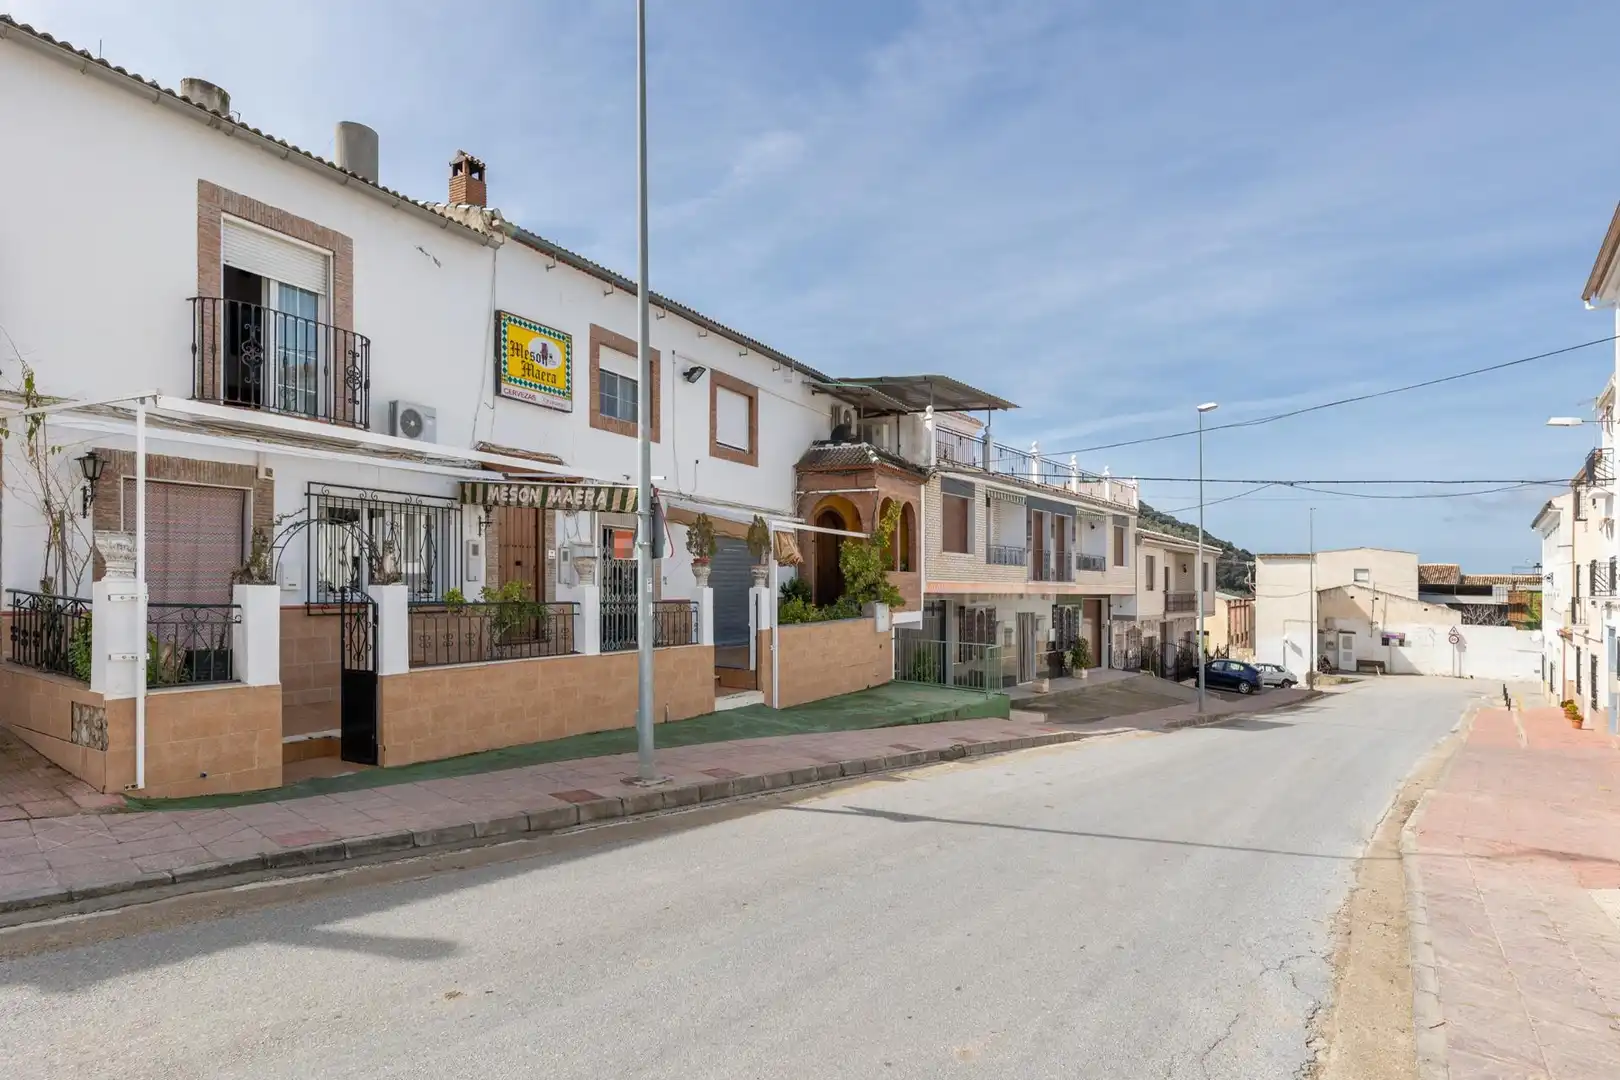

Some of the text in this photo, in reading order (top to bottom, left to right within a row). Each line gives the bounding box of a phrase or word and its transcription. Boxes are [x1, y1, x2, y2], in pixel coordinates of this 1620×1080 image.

[520, 360, 557, 384] Maera
[503, 387, 537, 401] CERVEZAS
[487, 485, 607, 506] MESON MAERA
